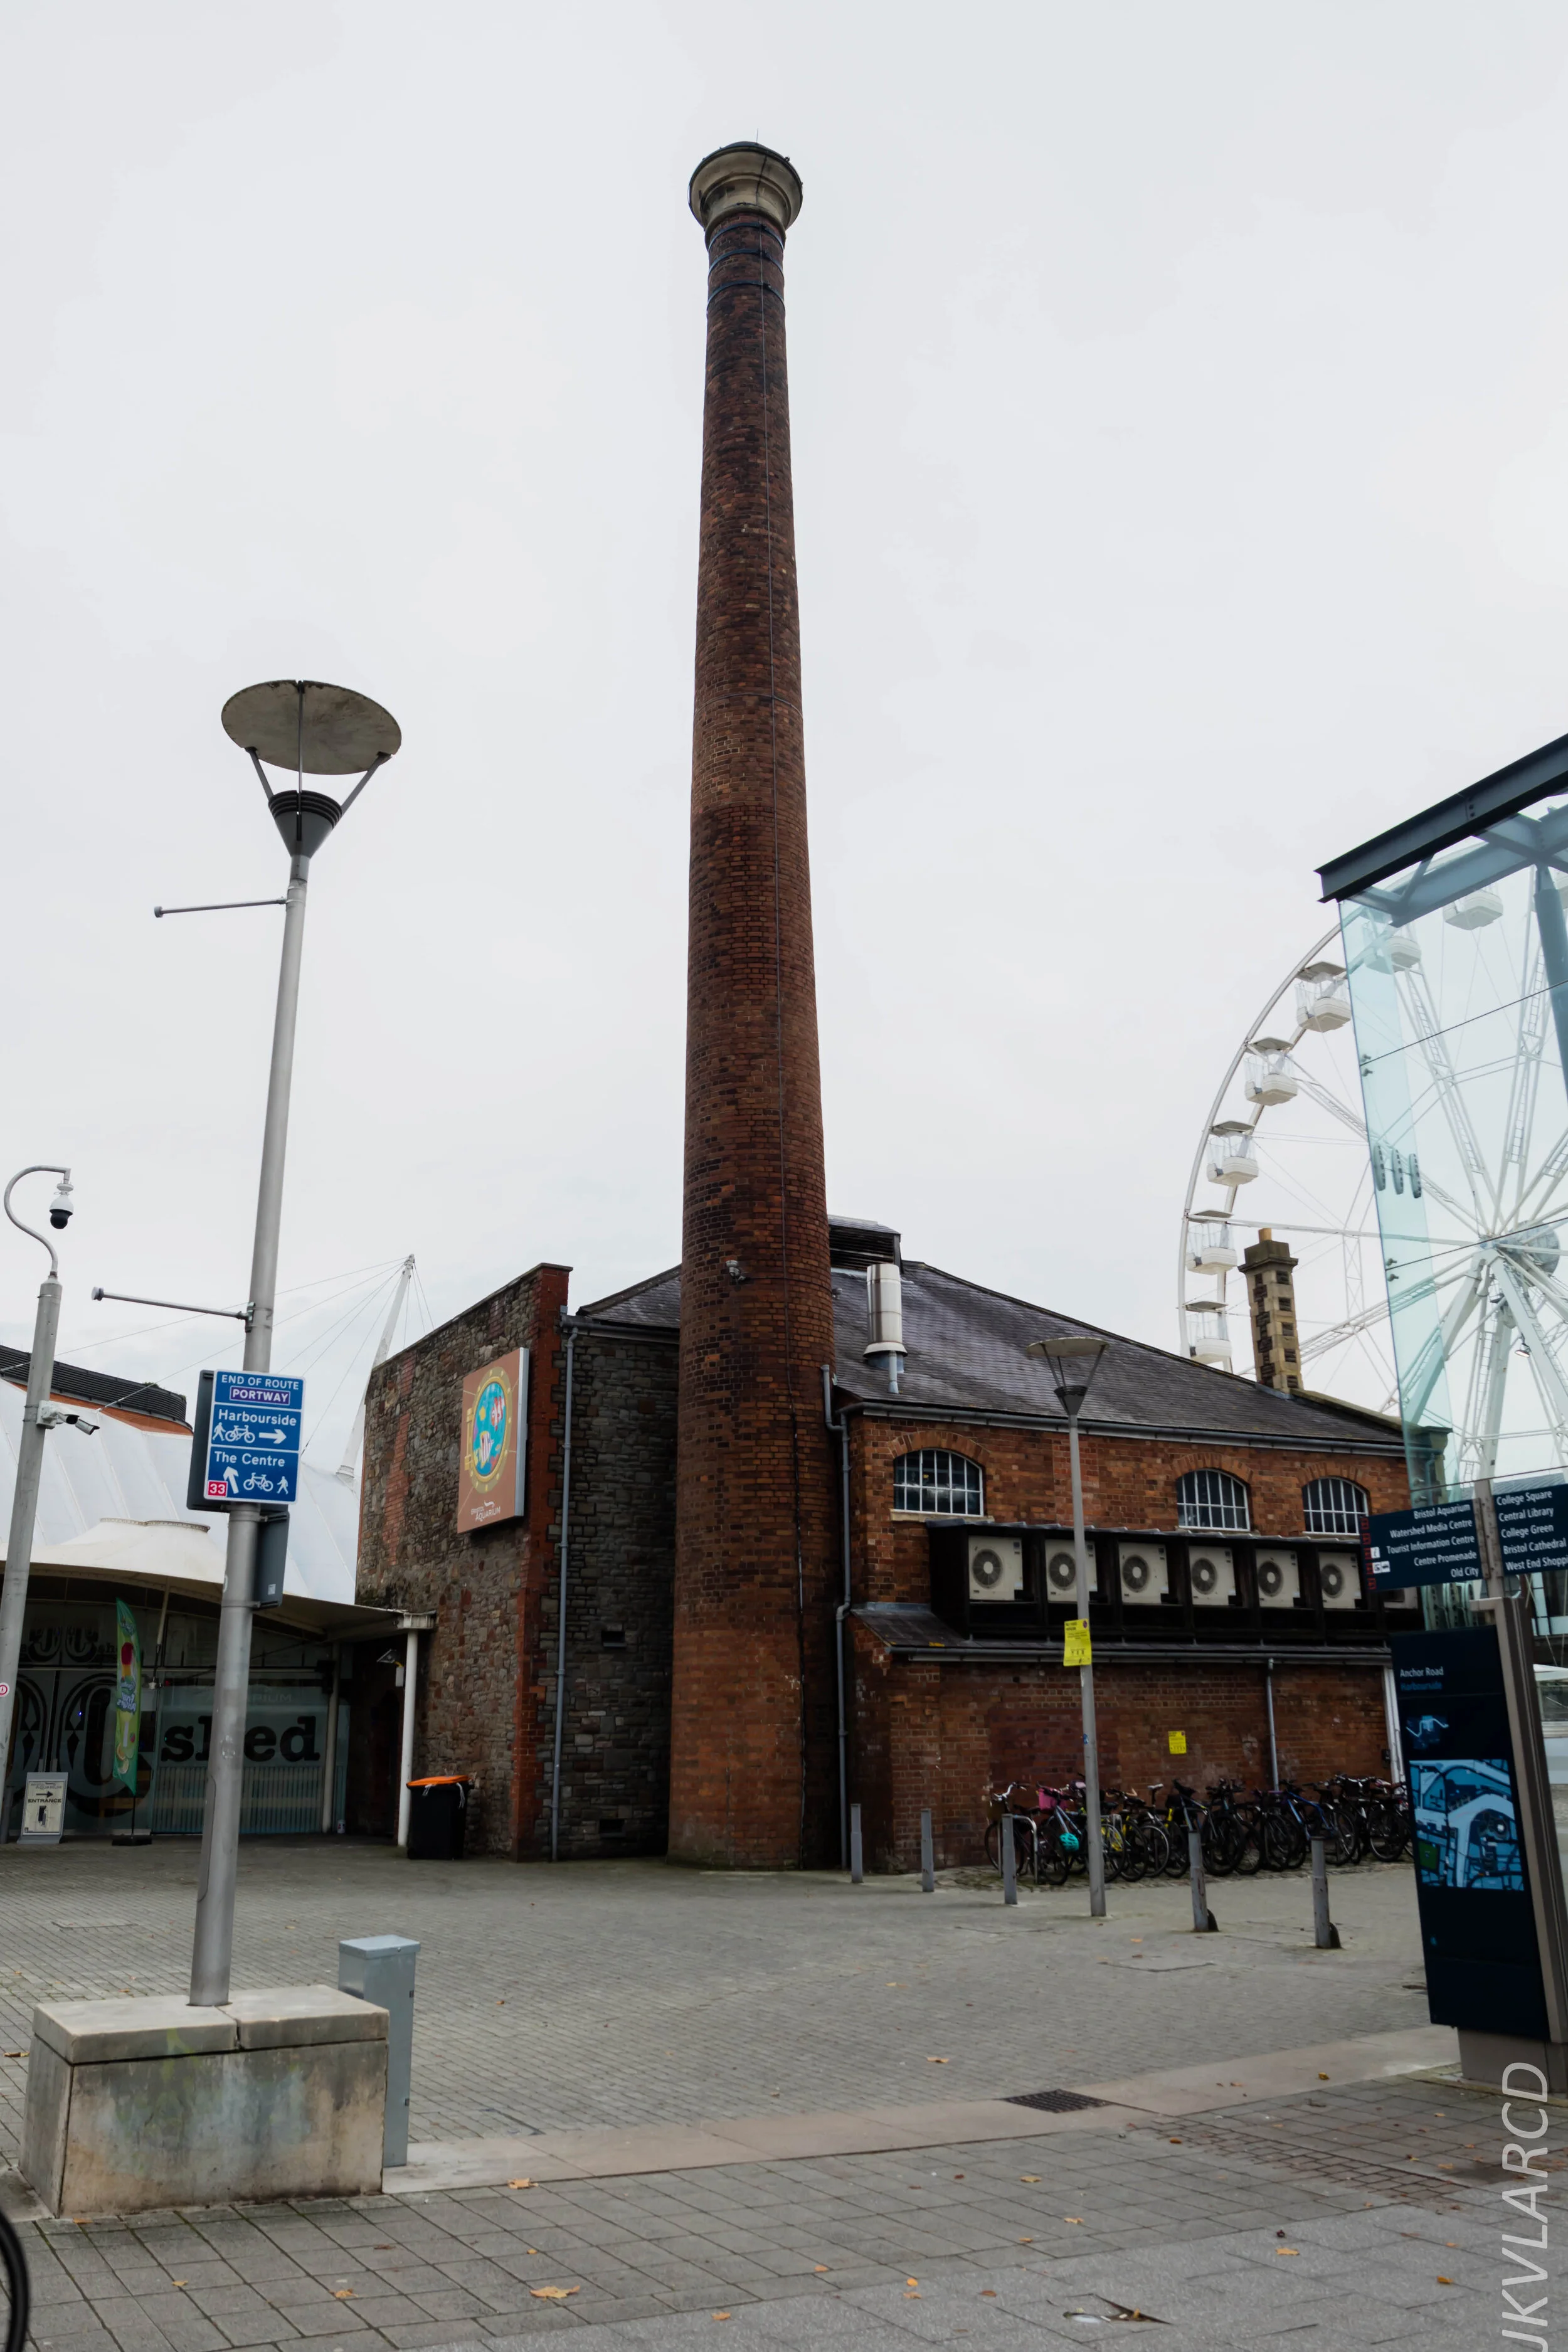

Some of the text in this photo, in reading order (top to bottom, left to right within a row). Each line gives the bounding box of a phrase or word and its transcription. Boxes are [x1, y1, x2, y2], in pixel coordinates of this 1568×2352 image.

[221, 1374, 299, 1390] END OF ROUTE
[232, 1389, 289, 1402] PORTWAY
[218, 1409, 297, 1426] Harbourside
[214, 1451, 285, 1467] The Centre
[209, 1483, 226, 1494] 33
[1496, 1491, 1552, 1506] College Square
[475, 1505, 501, 1522] AQUARIUM
[1414, 1503, 1471, 1519] Bristol Aquarium
[1498, 1507, 1554, 1522] Central Library
[1389, 1520, 1473, 1539] Watershed Media Centre
[1500, 1524, 1554, 1538] College Green
[1386, 1535, 1475, 1554] Tourist Information Centre
[1503, 1537, 1567, 1555] Bristol Cathedral
[1414, 1550, 1477, 1566] Centre Promenade
[1505, 1560, 1525, 1571] West
[1525, 1557, 1542, 1568] End
[1450, 1566, 1479, 1577] Old City
[1400, 1666, 1444, 1677] Anchor Road
